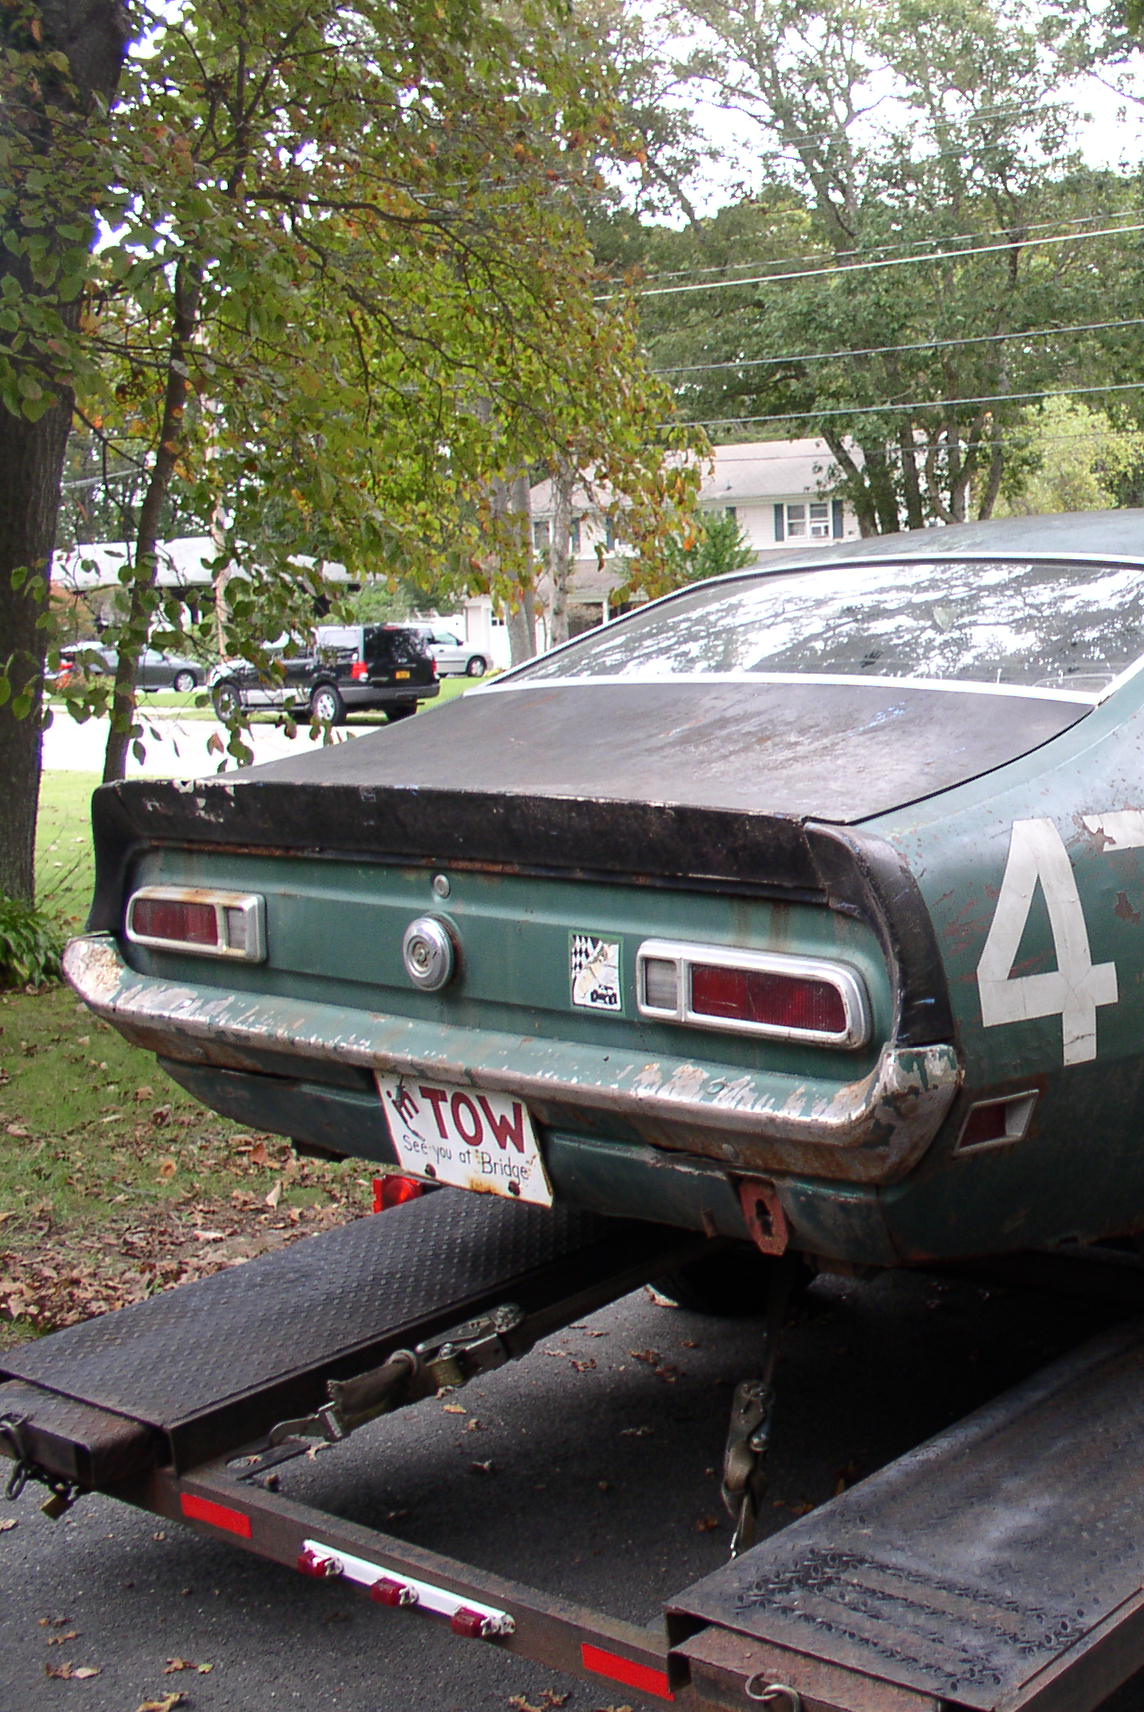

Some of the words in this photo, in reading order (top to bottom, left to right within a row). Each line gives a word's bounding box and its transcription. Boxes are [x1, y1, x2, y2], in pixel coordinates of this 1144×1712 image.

[419, 1085, 525, 1154] TOW
[402, 1133, 429, 1155] See
[431, 1144, 453, 1164] you
[459, 1150, 473, 1164] at
